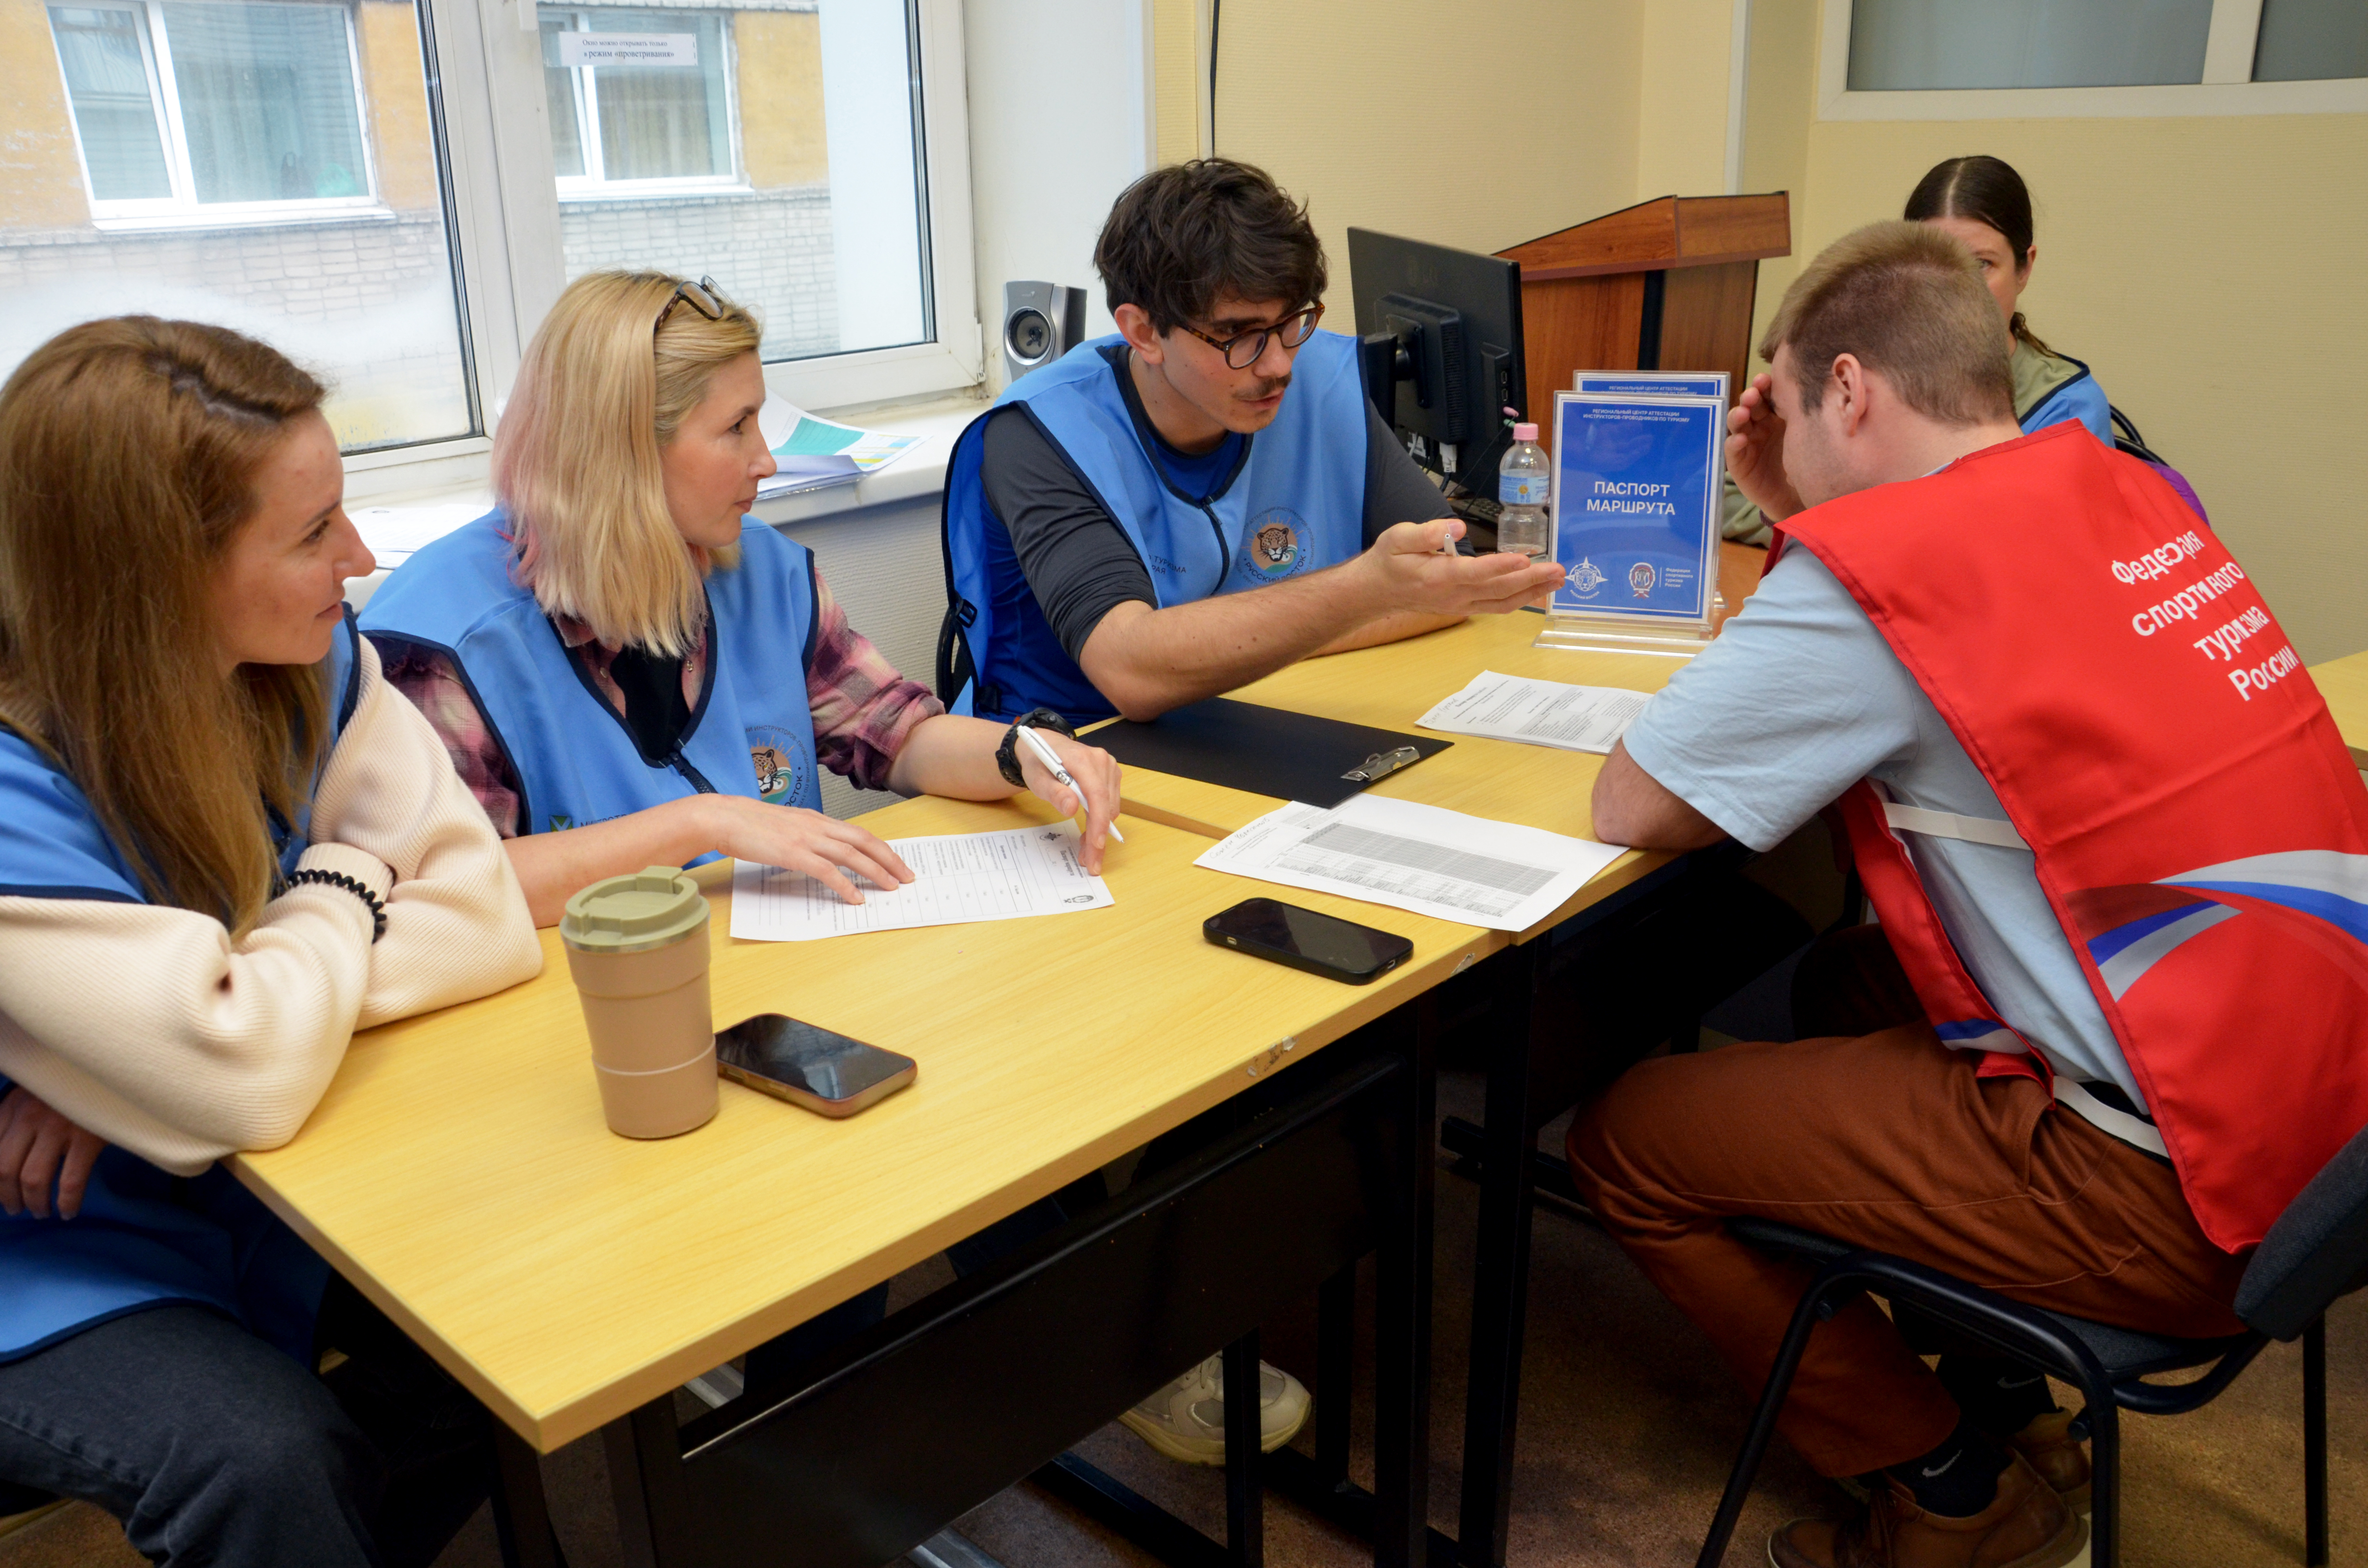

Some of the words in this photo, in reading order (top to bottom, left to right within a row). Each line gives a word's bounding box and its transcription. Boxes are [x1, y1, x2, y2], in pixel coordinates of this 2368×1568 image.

[615, 51, 674, 59] «проветривания»
[1594, 481, 1670, 497] ПАСПОРТ
[1587, 499, 1676, 515] МАРШРУТА
[1154, 555, 1186, 573] ТУРИЗМА
[2227, 645, 2299, 701] России
[784, 775, 803, 807] ОСТОК
